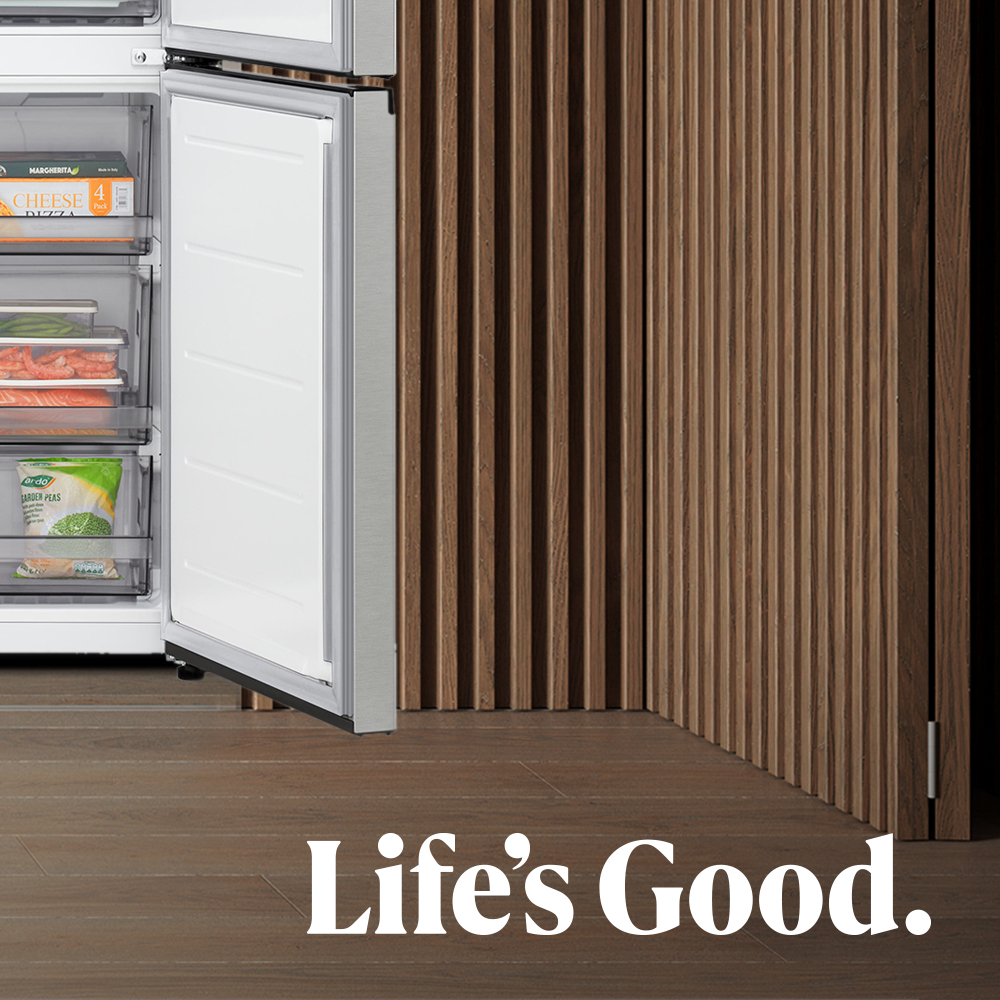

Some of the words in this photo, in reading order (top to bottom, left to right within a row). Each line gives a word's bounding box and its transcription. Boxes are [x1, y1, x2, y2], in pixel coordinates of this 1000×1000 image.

[29, 166, 72, 175] MARGHERITA
[93, 183, 105, 201] 4
[13, 193, 84, 208] CHEESE
[93, 202, 108, 210] Pack
[24, 476, 49, 486] ardo
[44, 493, 62, 502] PEAS
